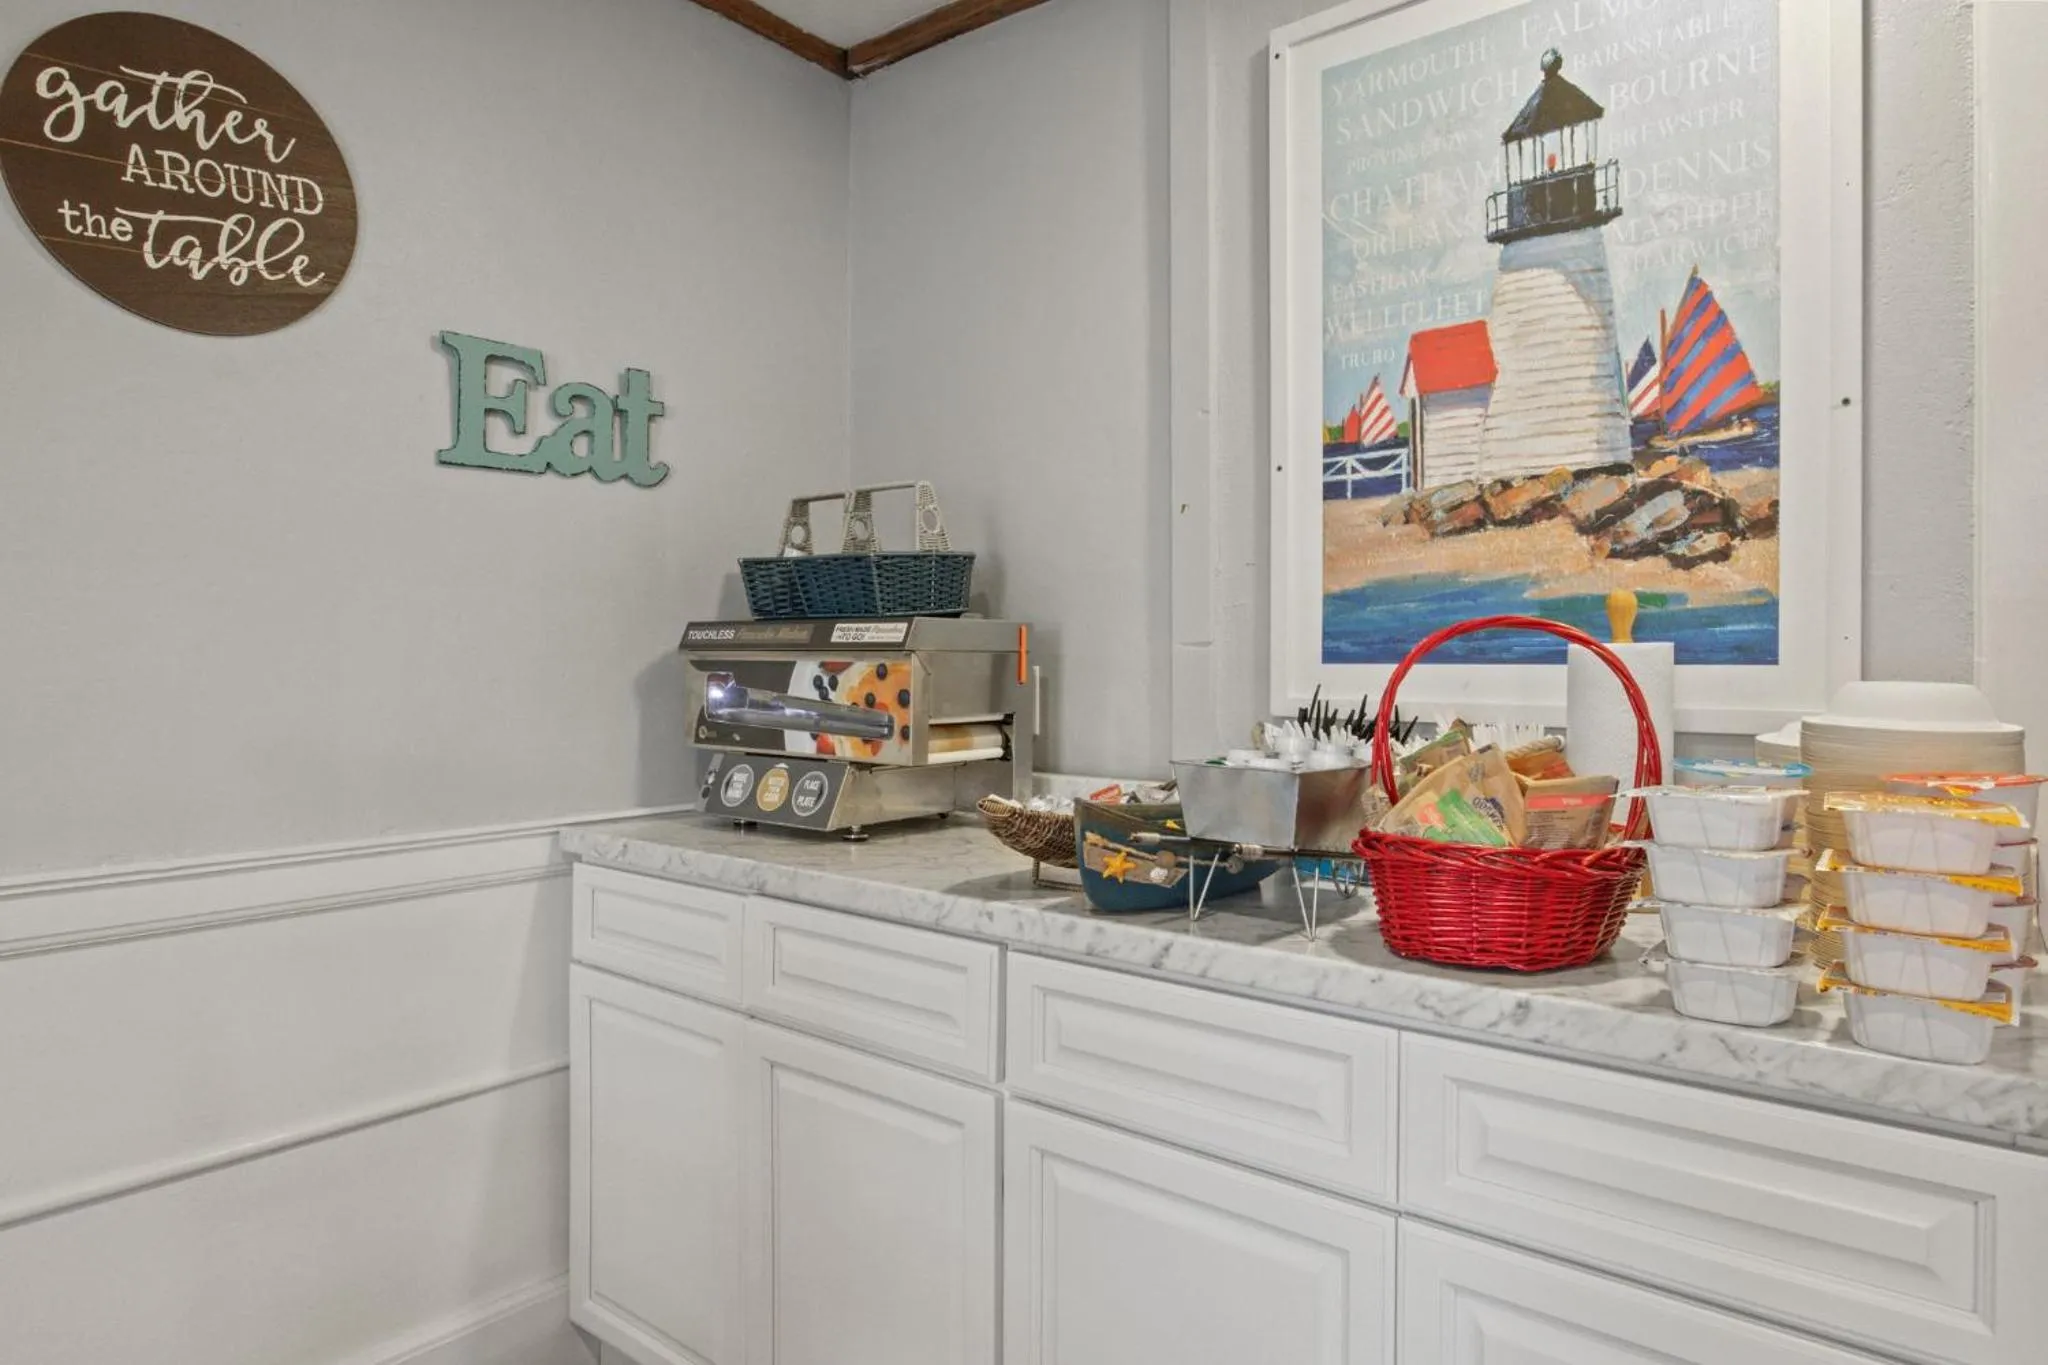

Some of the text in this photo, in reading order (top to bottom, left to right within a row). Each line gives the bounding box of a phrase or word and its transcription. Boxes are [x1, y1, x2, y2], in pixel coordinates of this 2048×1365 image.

[1331, 36, 1487, 106] YARMOUTH
[1573, 2, 1736, 72] BARNSTABLE
[1335, 67, 1520, 145] SANDWICH
[1608, 39, 1772, 112] BOURNE
[35, 66, 296, 164] gather
[1607, 98, 1745, 154] BREWSTER
[121, 143, 324, 216] AROUND
[1329, 157, 1503, 223] CHATHAM
[1623, 135, 1773, 199] DENNIS
[58, 199, 325, 287] the table
[1325, 288, 1487, 341] WELLFLEET
[1340, 346, 1396, 371] TRURO
[436, 329, 670, 488] Eat
[686, 628, 736, 641] TOUCHLESS
